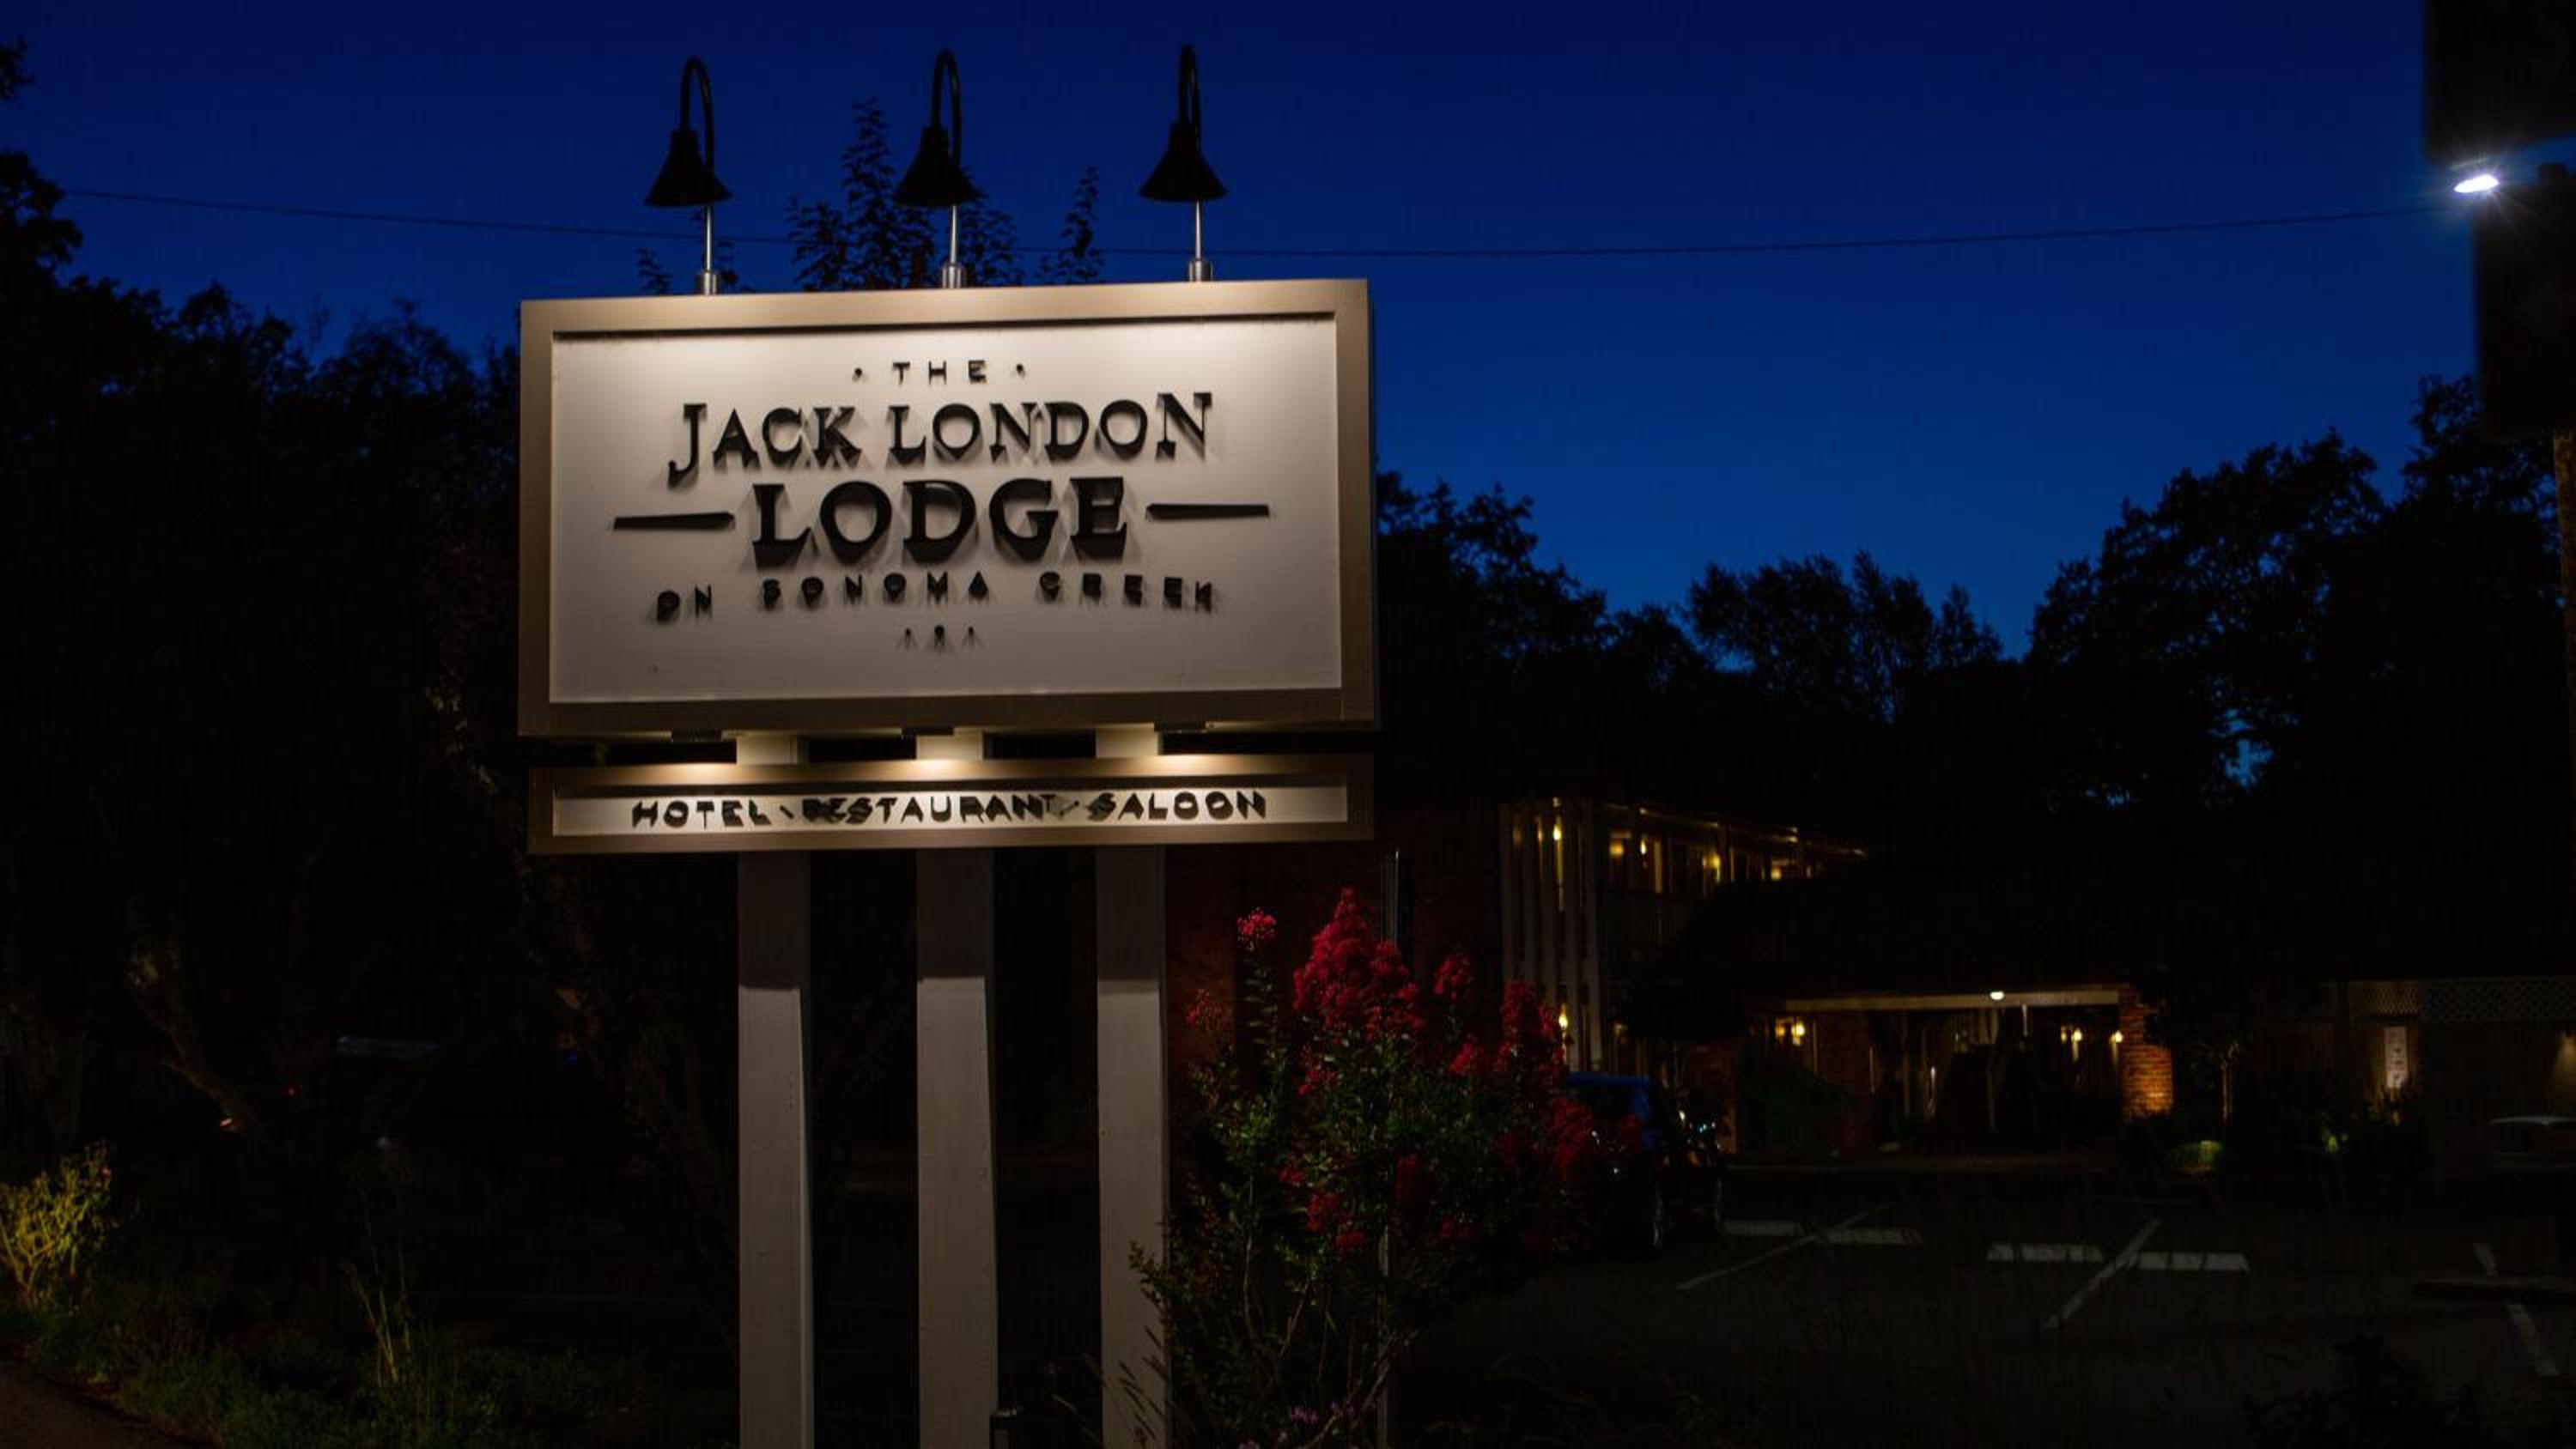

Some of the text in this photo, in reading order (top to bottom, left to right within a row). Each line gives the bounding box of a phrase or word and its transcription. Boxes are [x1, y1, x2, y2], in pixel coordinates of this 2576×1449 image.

[893, 360, 986, 385] THE
[668, 392, 1212, 489] JACK LONDON
[752, 476, 1127, 567] LODGE
[657, 570, 1212, 621] ON SONOMA CREEK
[632, 790, 1266, 829] HOTEL RESTAURANT SALOON
